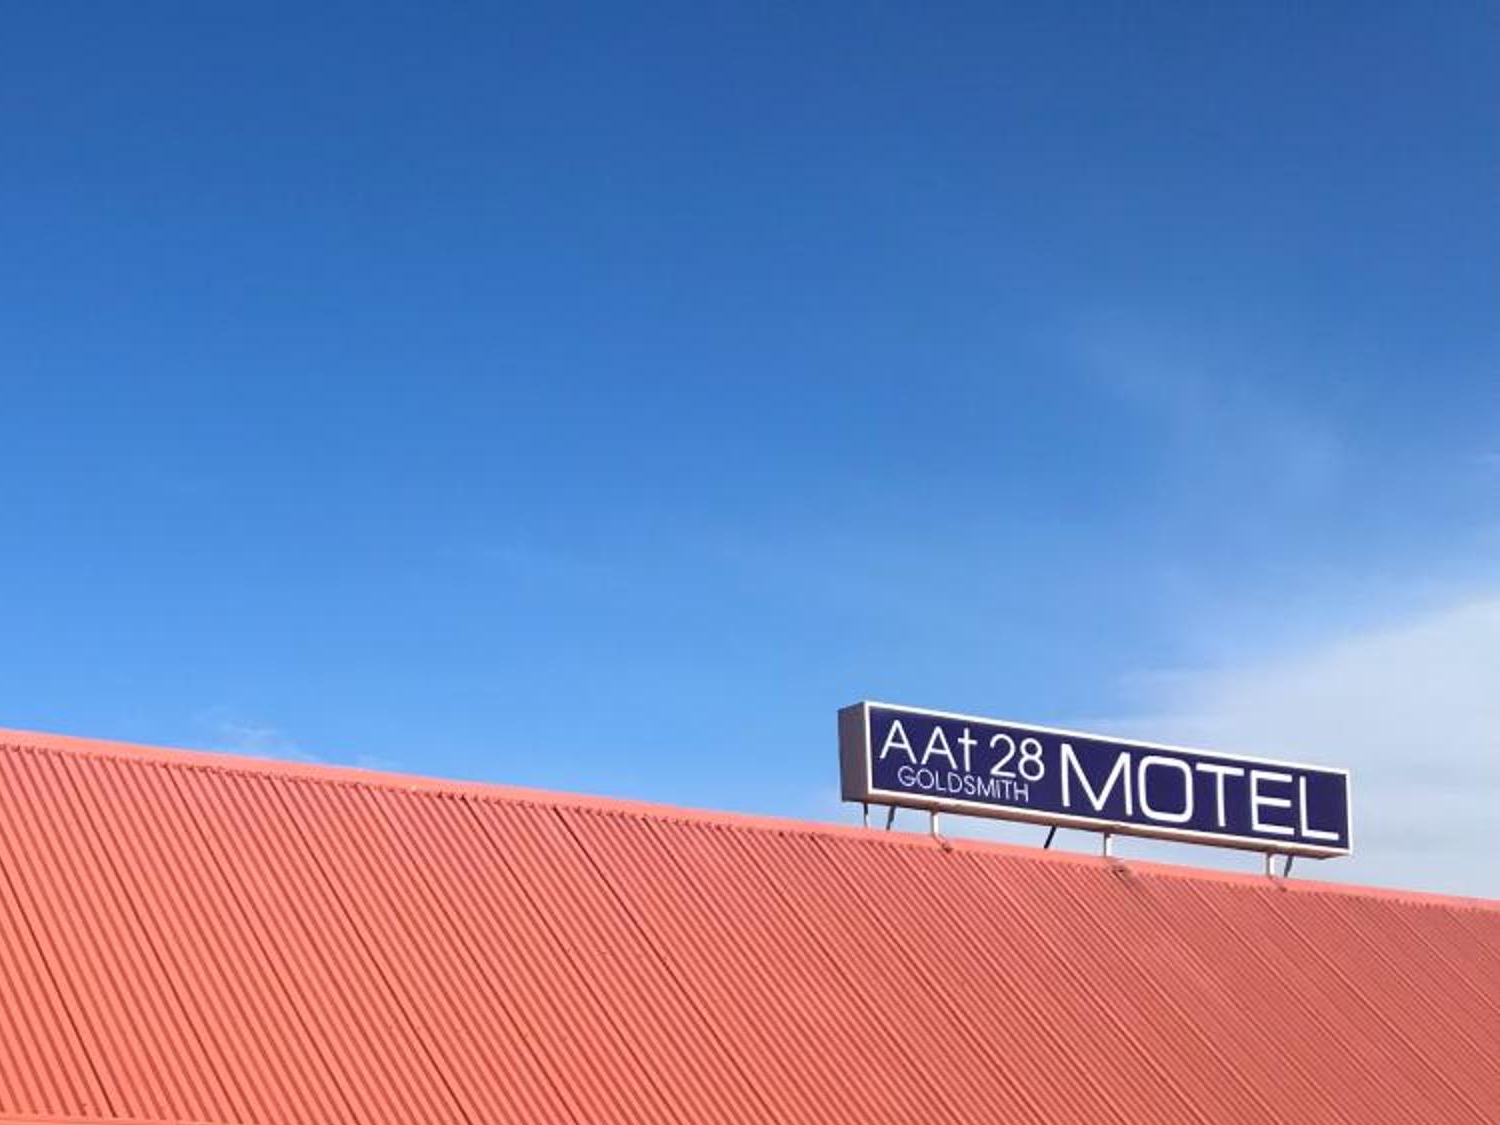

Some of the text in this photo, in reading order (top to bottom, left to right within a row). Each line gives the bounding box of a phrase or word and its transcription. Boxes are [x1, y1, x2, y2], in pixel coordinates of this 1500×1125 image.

[879, 720, 1045, 781] AAt 28
[897, 765, 1029, 802] GOLDSMITH
[1060, 743, 1339, 841] MOTEL
